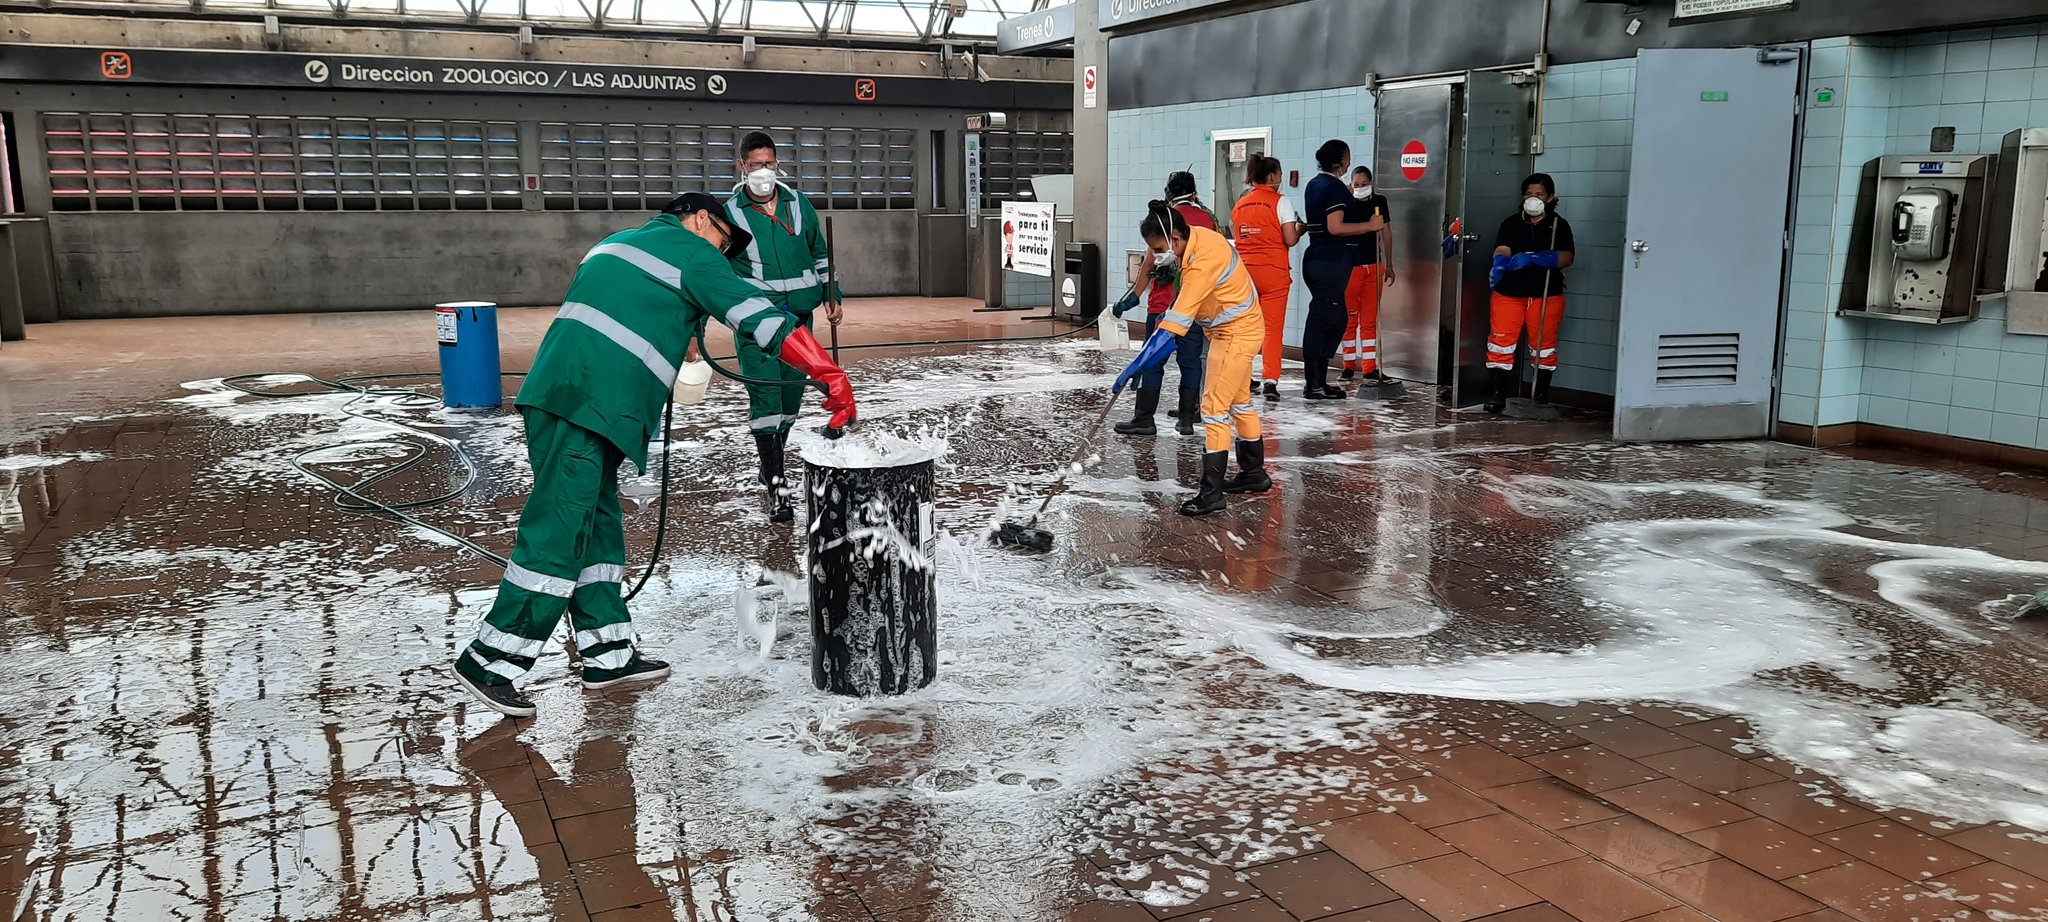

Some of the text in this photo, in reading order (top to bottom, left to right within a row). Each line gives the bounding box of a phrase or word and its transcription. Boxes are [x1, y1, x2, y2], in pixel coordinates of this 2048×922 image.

[1016, 24, 1043, 41] Trenes
[341, 64, 697, 91] Direccion ZOOLOGICO / LAS ADJUNTAS
[1919, 162, 1944, 170] CANTV
[1019, 220, 1048, 231] para ti
[1019, 243, 1048, 256] servicio
